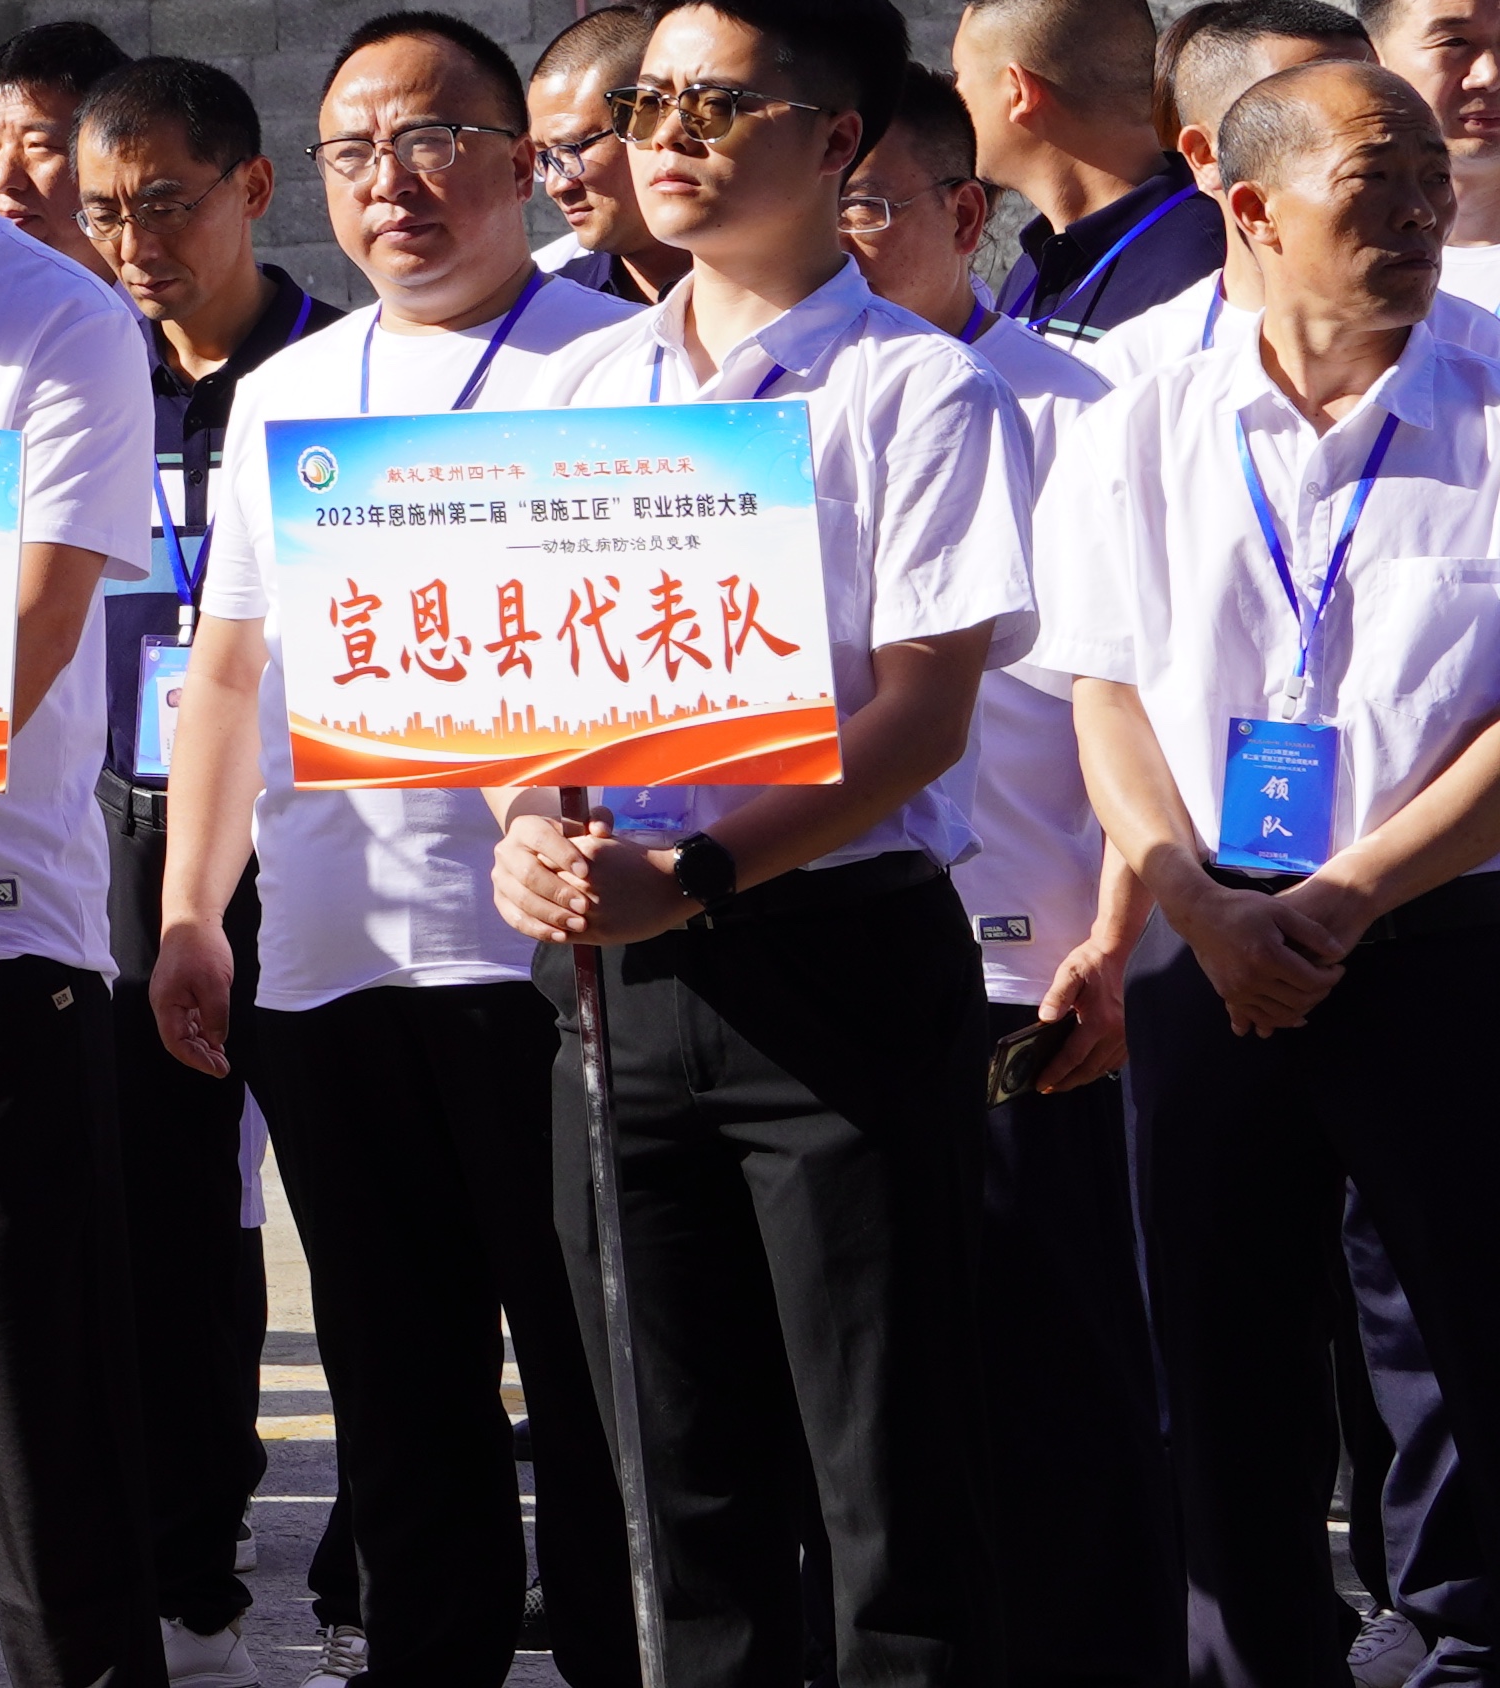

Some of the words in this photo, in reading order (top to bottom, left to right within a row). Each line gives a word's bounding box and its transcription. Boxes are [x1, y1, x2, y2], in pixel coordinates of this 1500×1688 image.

[387, 464, 526, 484] 献礼建州四十年
[552, 457, 696, 478] 恩施工匠展风采
[316, 492, 758, 527] 2023年恩施州第二届“恩施工匠”职业技能大赛
[329, 569, 801, 687] 宣恩县代表队
[635, 789, 651, 808] 手
[1260, 775, 1293, 839] 领队
